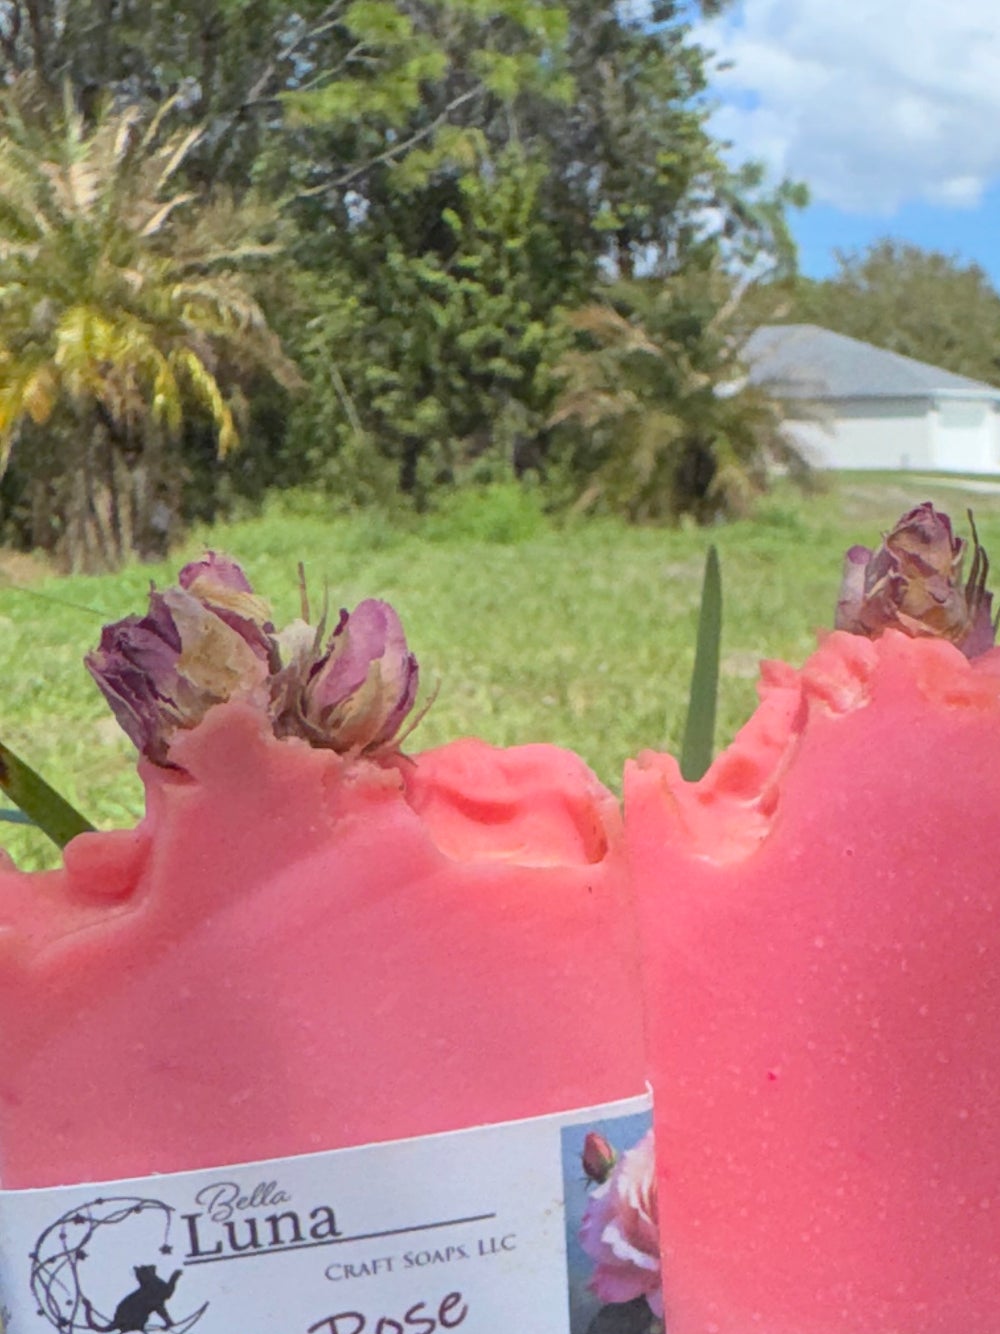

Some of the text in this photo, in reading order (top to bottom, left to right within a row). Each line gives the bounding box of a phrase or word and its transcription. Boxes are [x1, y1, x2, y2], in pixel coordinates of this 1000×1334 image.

[194, 1182, 291, 1219] Bella
[180, 1205, 342, 1257] Luna
[479, 1234, 518, 1255] LLC
